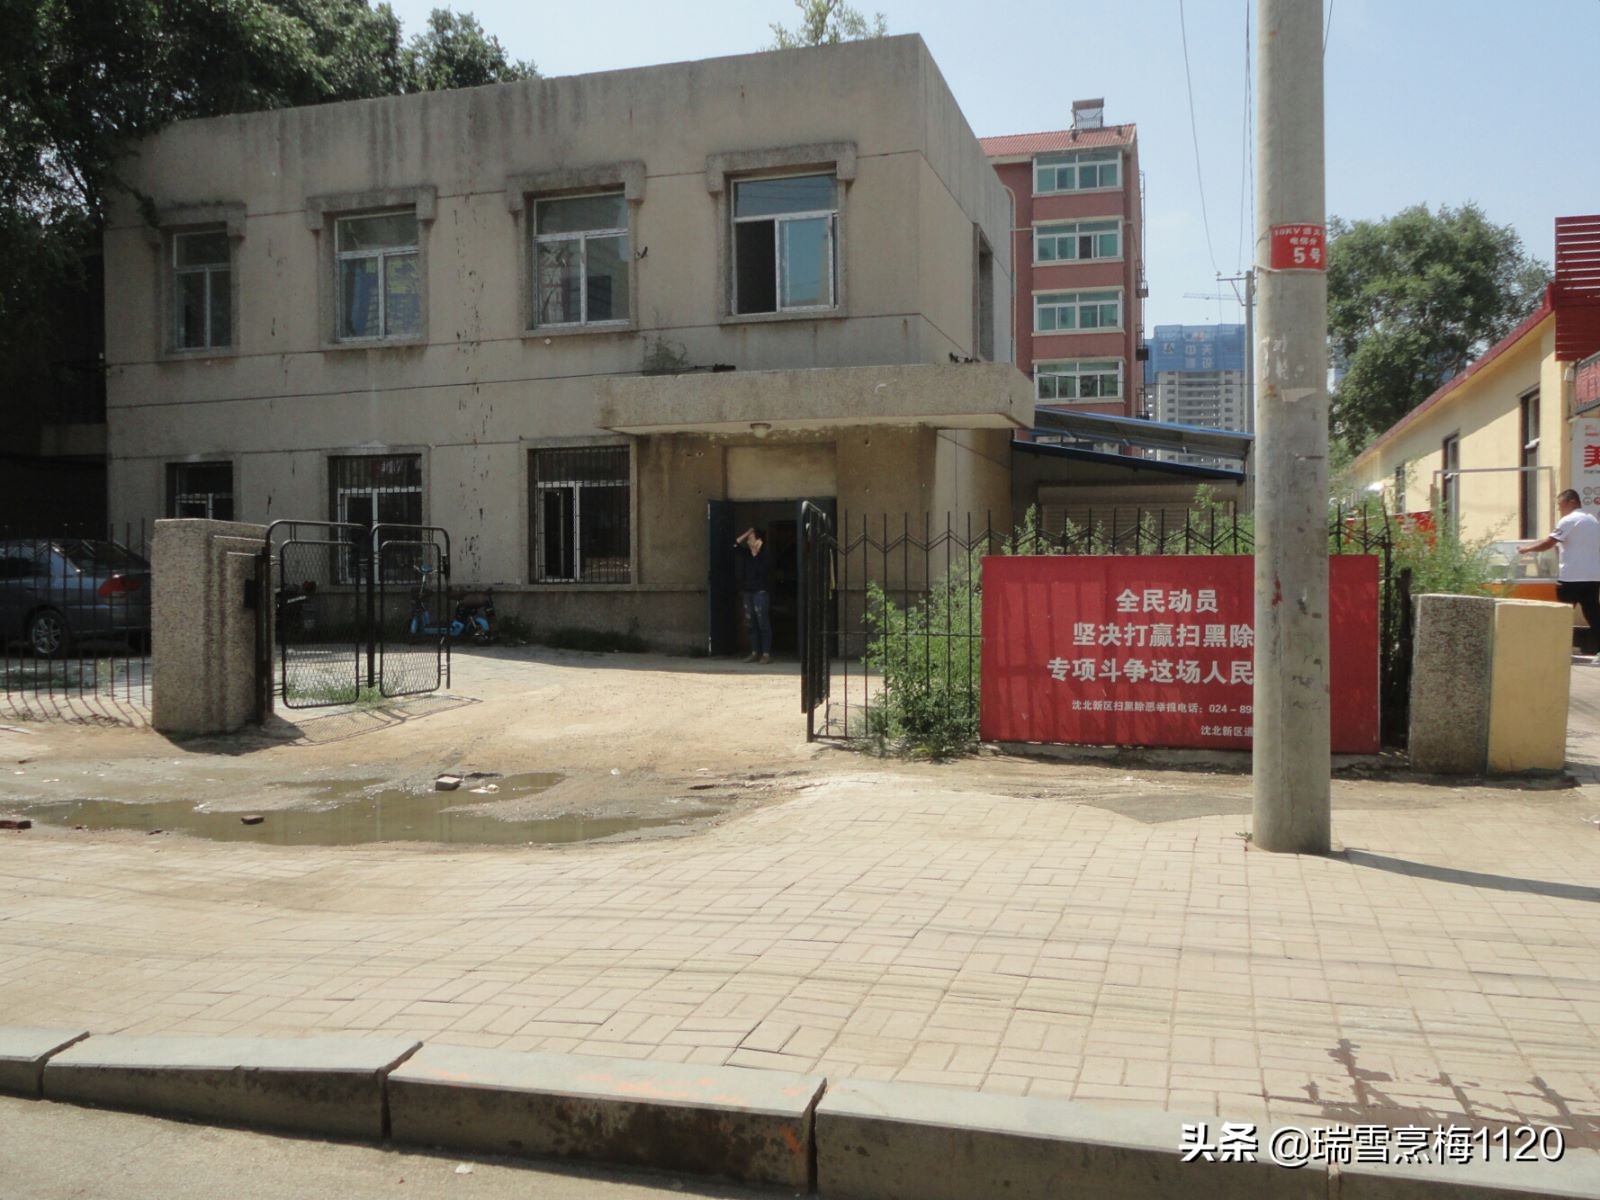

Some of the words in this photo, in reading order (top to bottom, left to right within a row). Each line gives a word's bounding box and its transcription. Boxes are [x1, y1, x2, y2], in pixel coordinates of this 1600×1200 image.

[1294, 247, 1321, 264] 5号
[1115, 589, 1219, 613] 全民动员
[1073, 623, 1254, 648] 坚决打赢扫黑除
[1047, 657, 1254, 684] 专项斗争这场人民
[1239, 705, 1254, 714] 89
